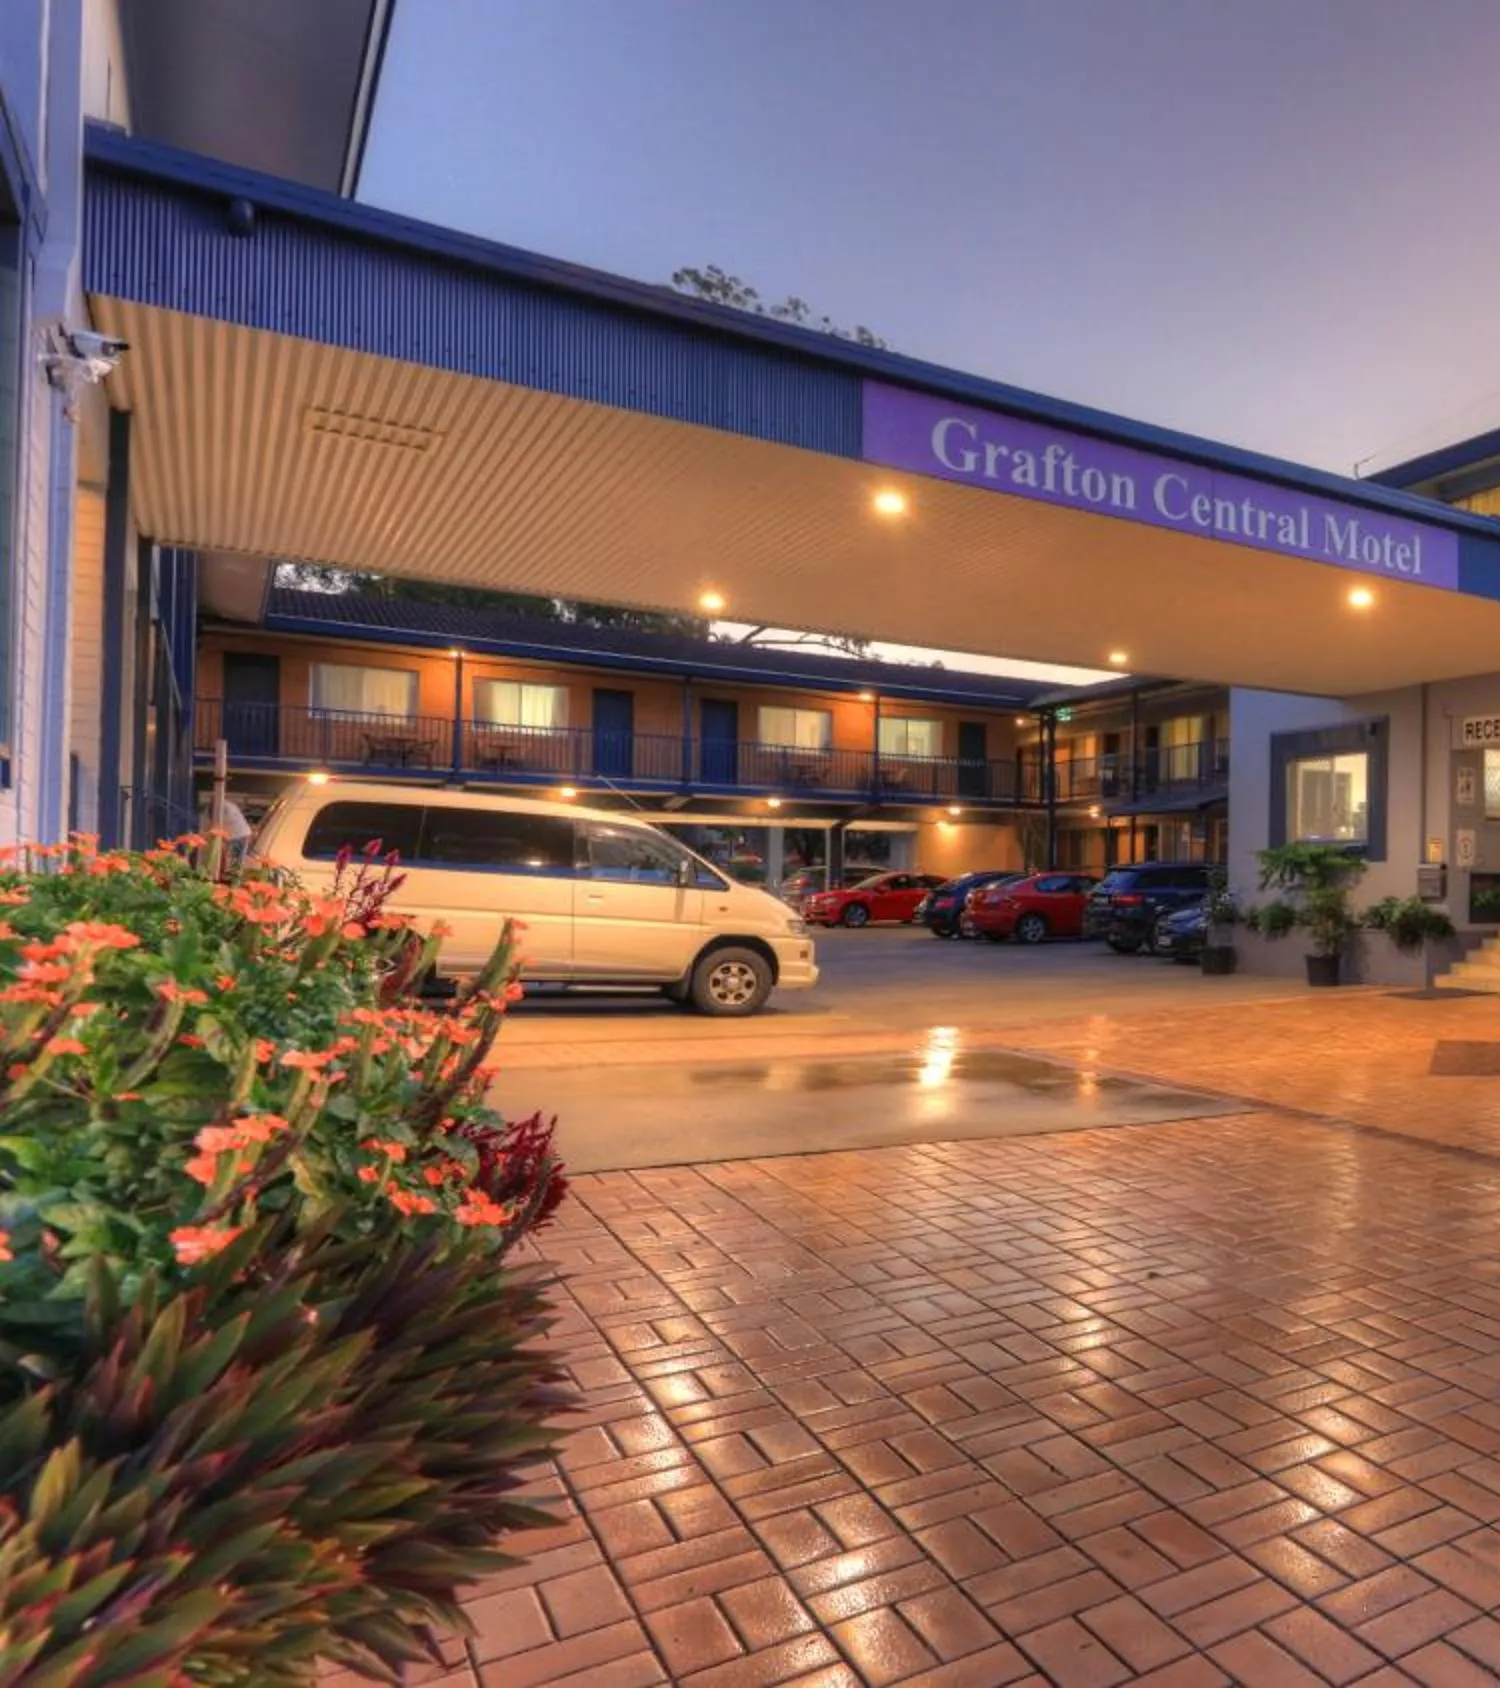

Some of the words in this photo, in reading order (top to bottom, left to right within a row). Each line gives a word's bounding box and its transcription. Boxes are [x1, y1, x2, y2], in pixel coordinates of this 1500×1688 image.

[930, 418, 1136, 509] Grafton
[1153, 472, 1310, 549] Central
[1323, 512, 1422, 575] Motel
